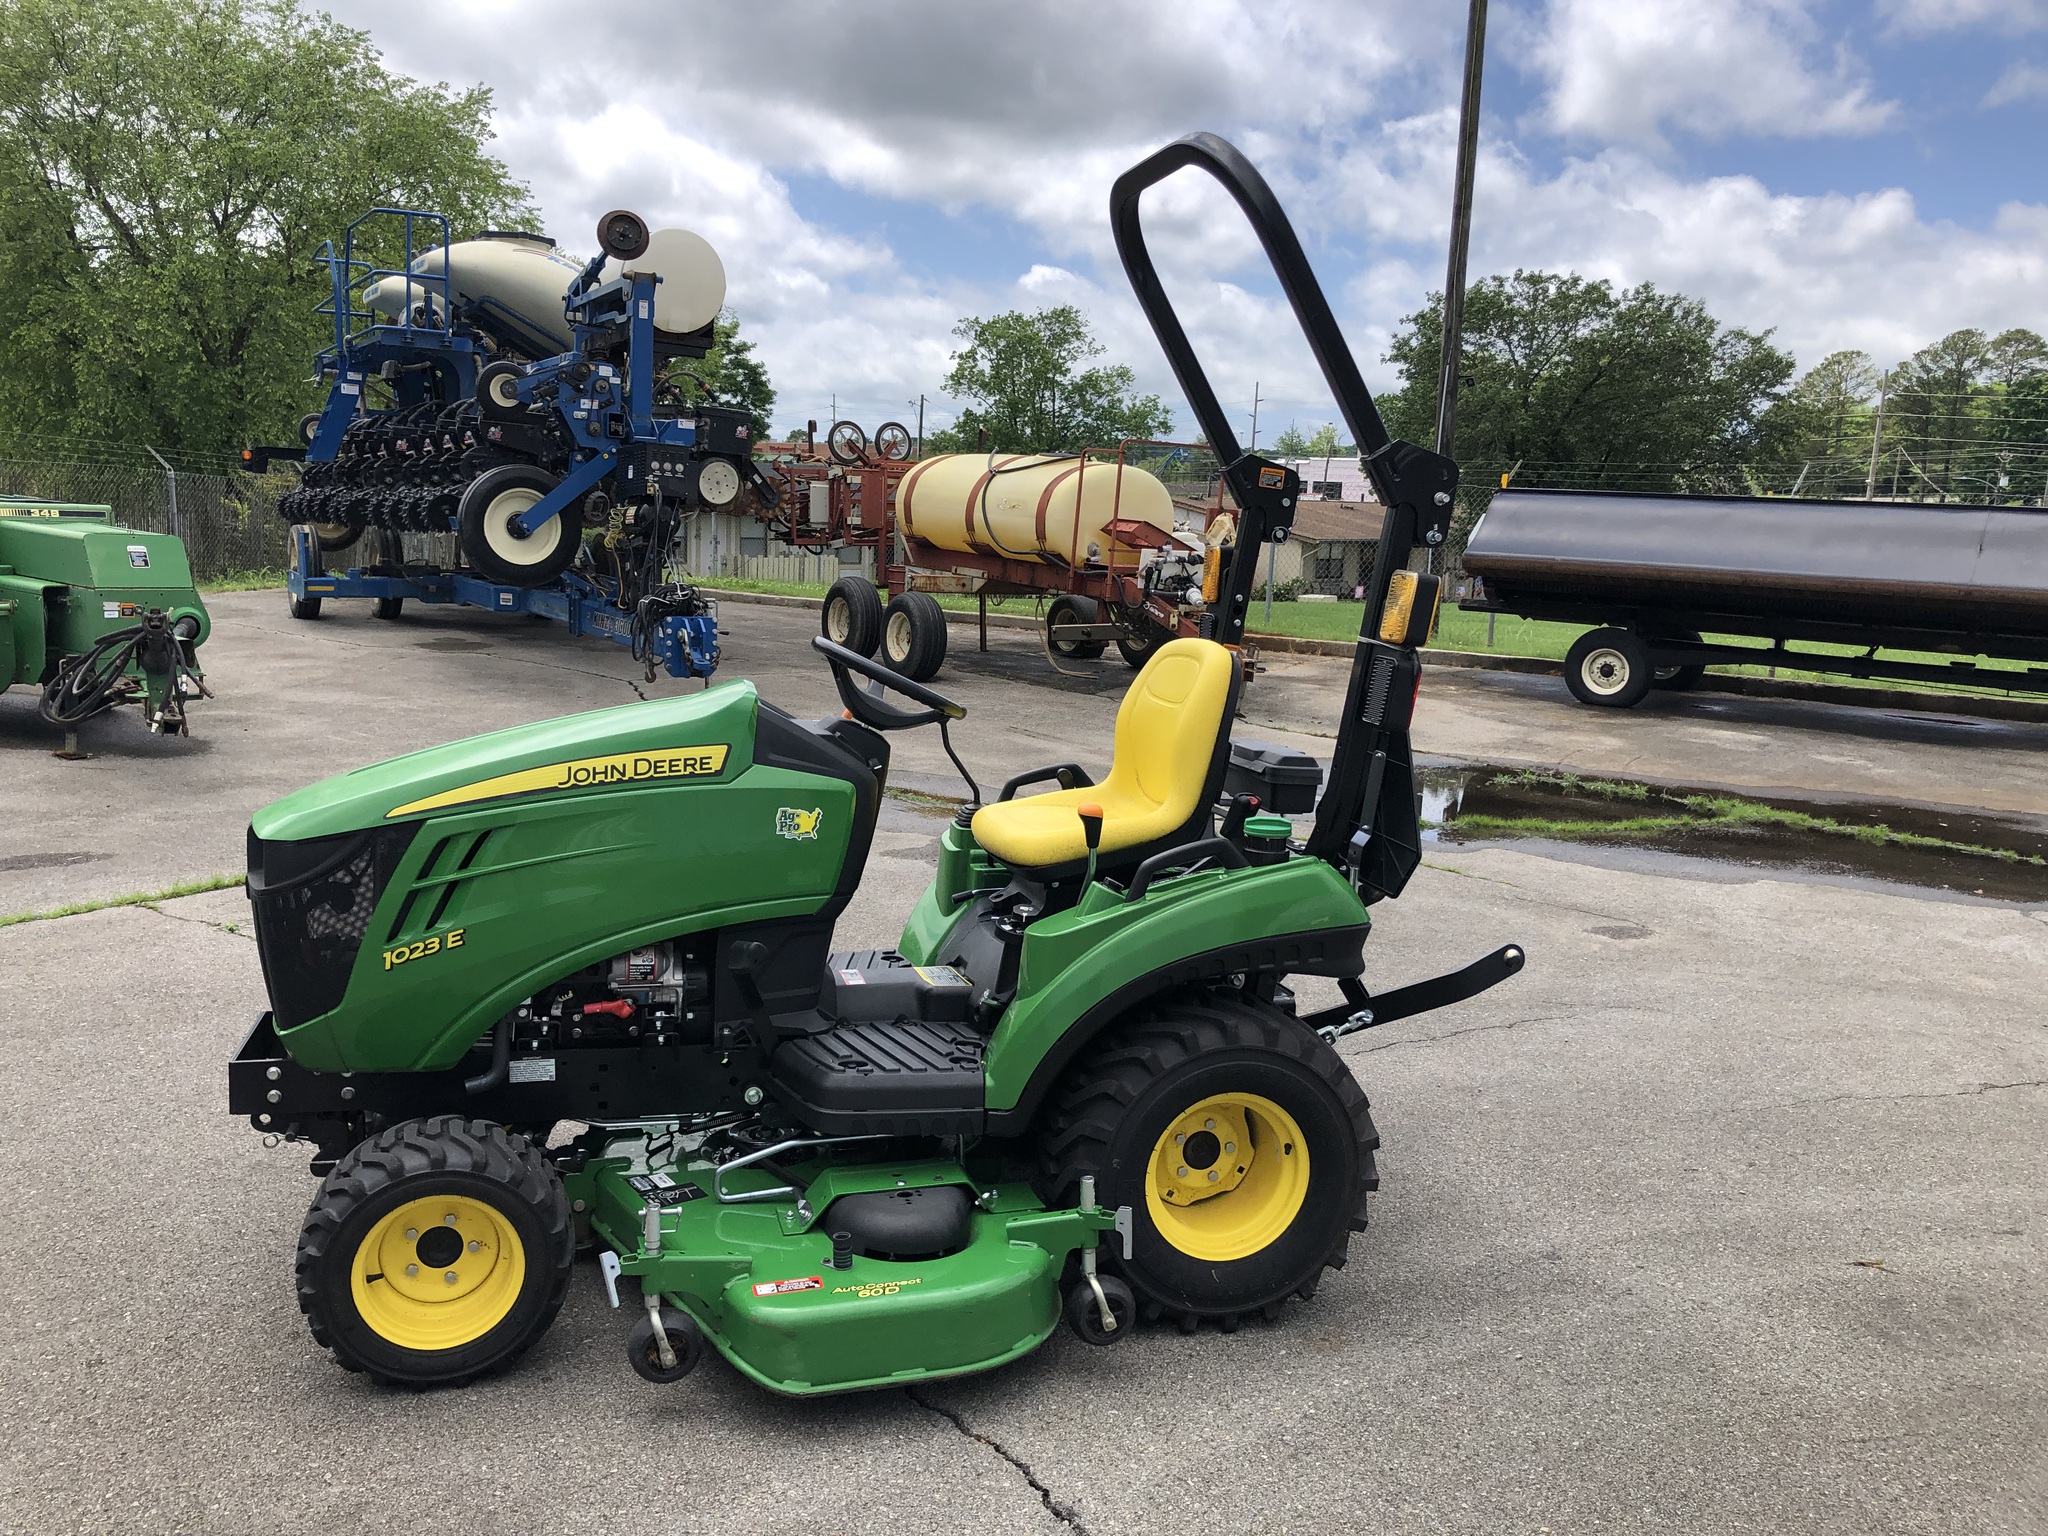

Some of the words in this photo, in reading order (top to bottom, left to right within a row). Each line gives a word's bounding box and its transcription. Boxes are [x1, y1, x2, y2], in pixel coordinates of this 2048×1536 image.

[30, 508, 60, 518] 348
[557, 762, 627, 787] JOHN
[633, 755, 713, 778] DEERE
[779, 810, 800, 822] Ag-
[779, 821, 800, 832] Pro
[383, 936, 441, 971] 1023
[447, 928, 465, 950] E
[857, 1286, 900, 1299] 60D
